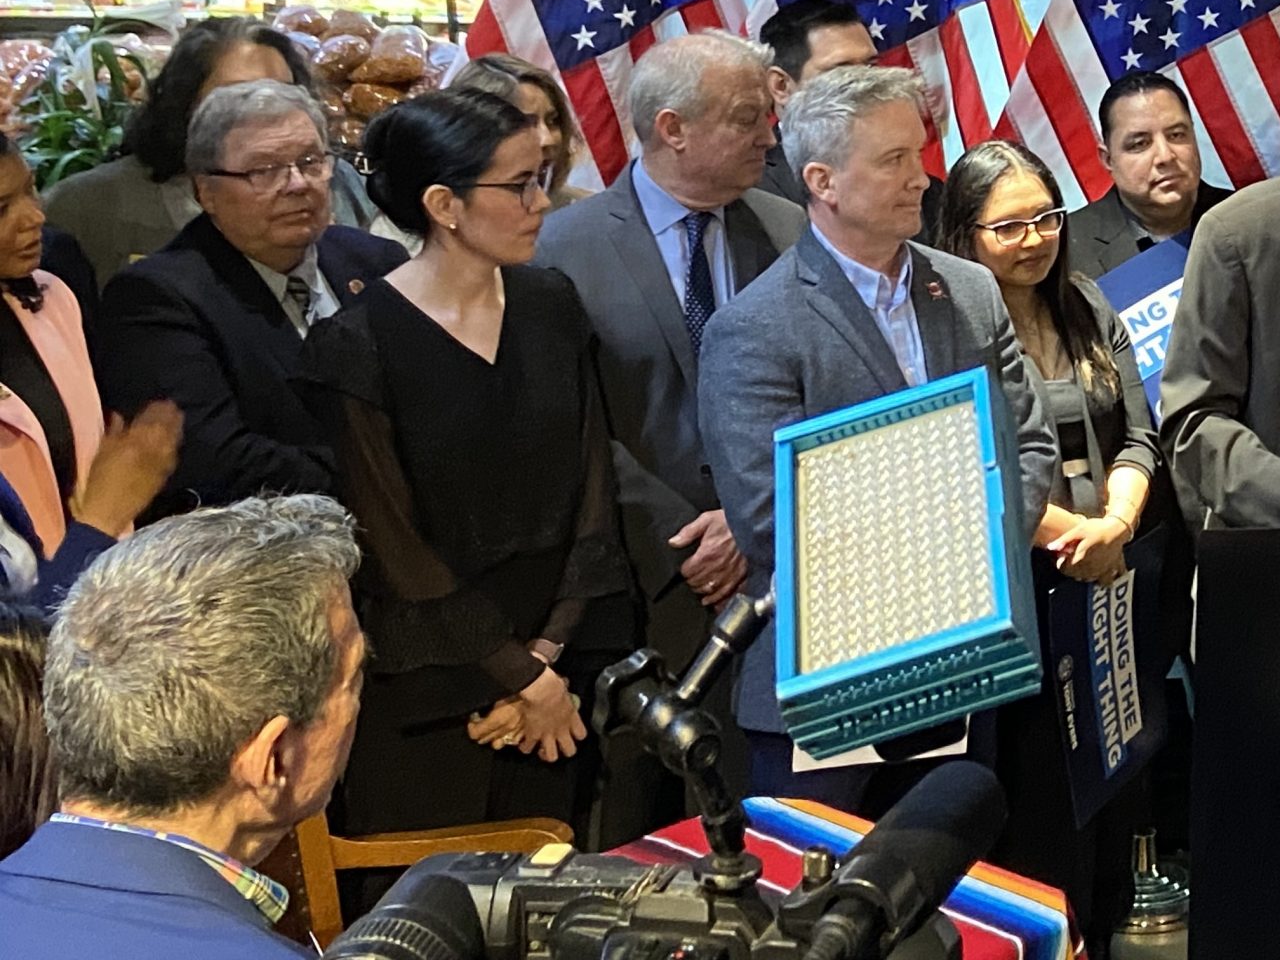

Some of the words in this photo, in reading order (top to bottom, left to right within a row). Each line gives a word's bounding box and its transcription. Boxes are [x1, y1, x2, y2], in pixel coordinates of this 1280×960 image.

[1114, 581, 1130, 671] DOING
[1098, 670, 1123, 770] THING
[1119, 672, 1140, 732] THE
